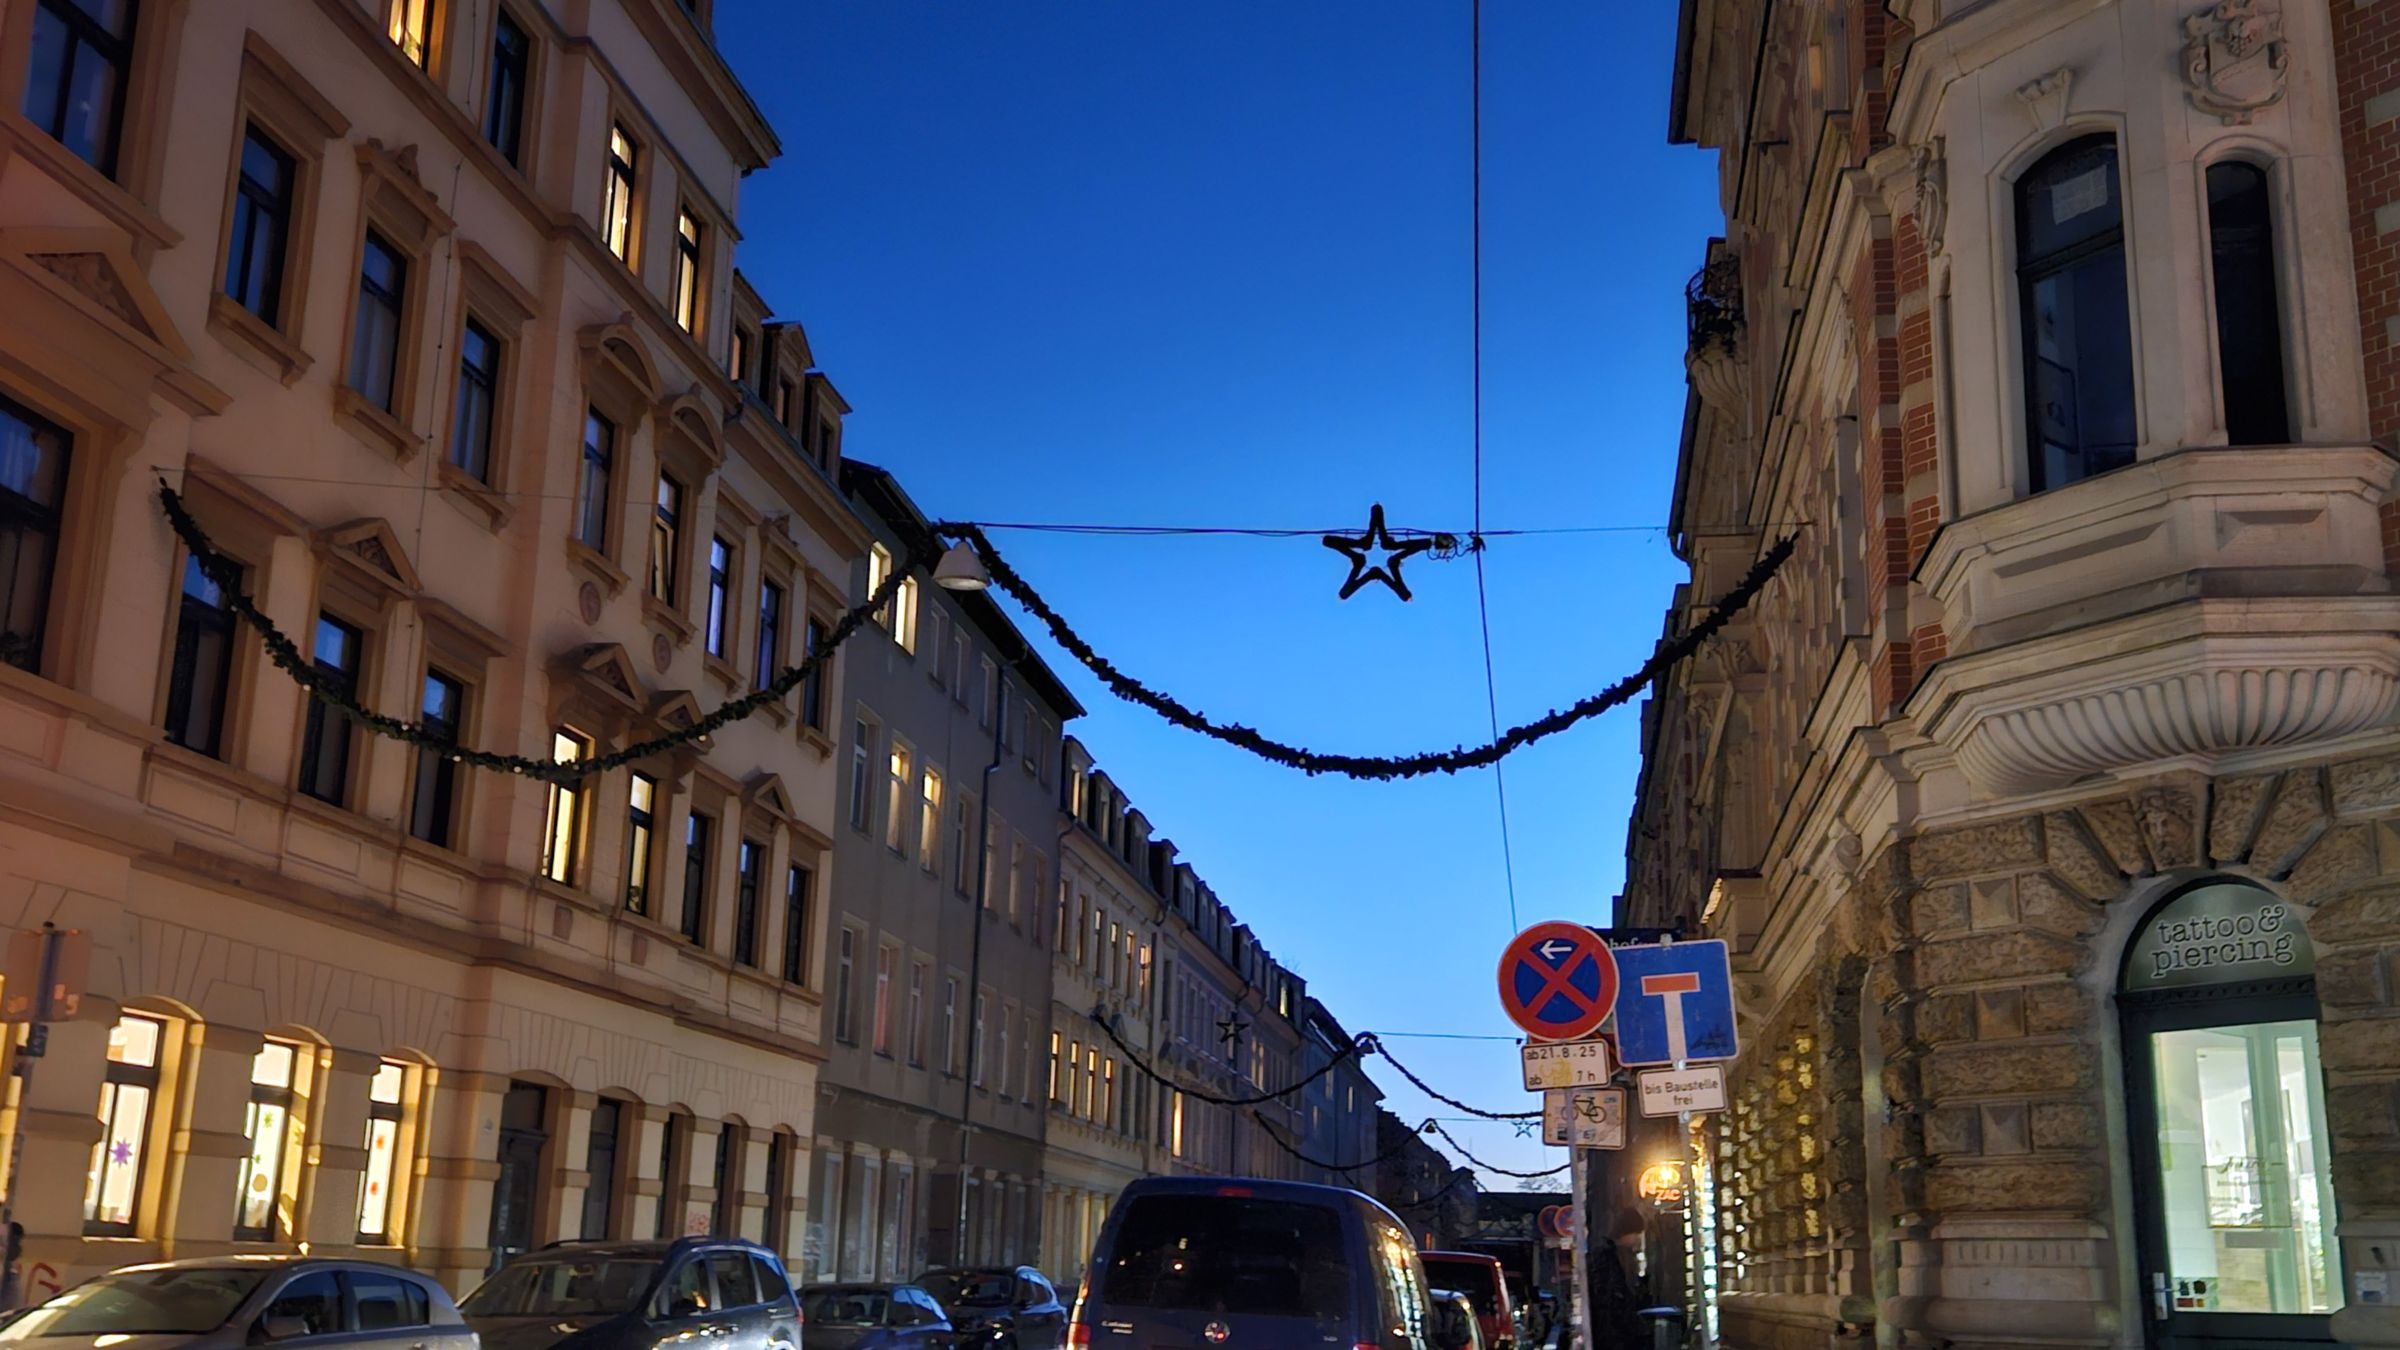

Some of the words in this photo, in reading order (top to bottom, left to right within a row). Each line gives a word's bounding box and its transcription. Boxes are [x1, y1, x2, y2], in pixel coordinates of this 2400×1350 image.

[2151, 933, 2295, 978] piercing
[1529, 1074, 1543, 1086] ab
[1644, 1083, 1662, 1095] bis
[1664, 1078, 1719, 1093] Baustelle
[1673, 1094, 1693, 1106] frei
